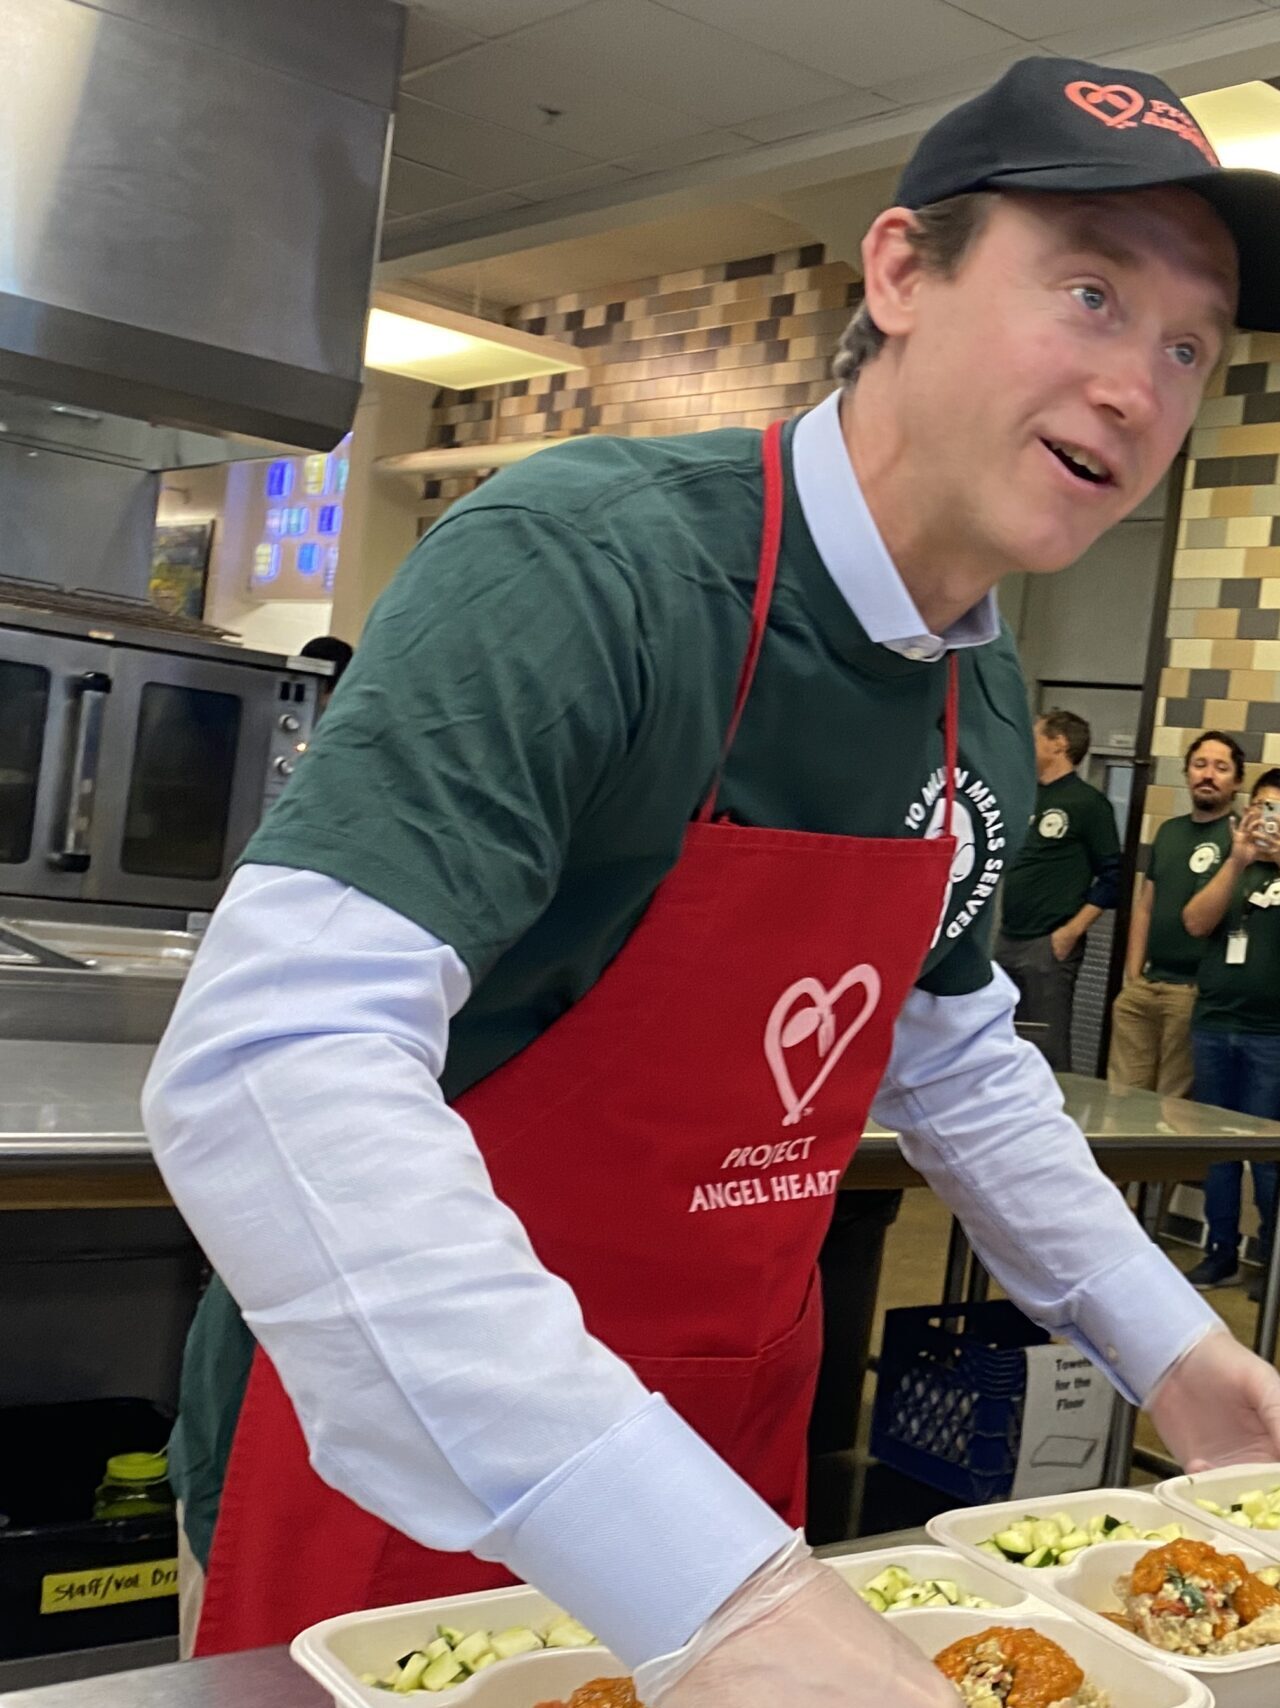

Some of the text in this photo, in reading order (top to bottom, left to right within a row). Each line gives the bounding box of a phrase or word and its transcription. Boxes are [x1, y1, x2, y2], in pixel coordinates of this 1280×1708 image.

[905, 803, 926, 830] 10
[965, 780, 1006, 852] MEALS
[946, 858, 1004, 938] SERVED
[720, 1136, 817, 1169] PROJECT
[688, 1169, 841, 1213] ANGEL HEART
